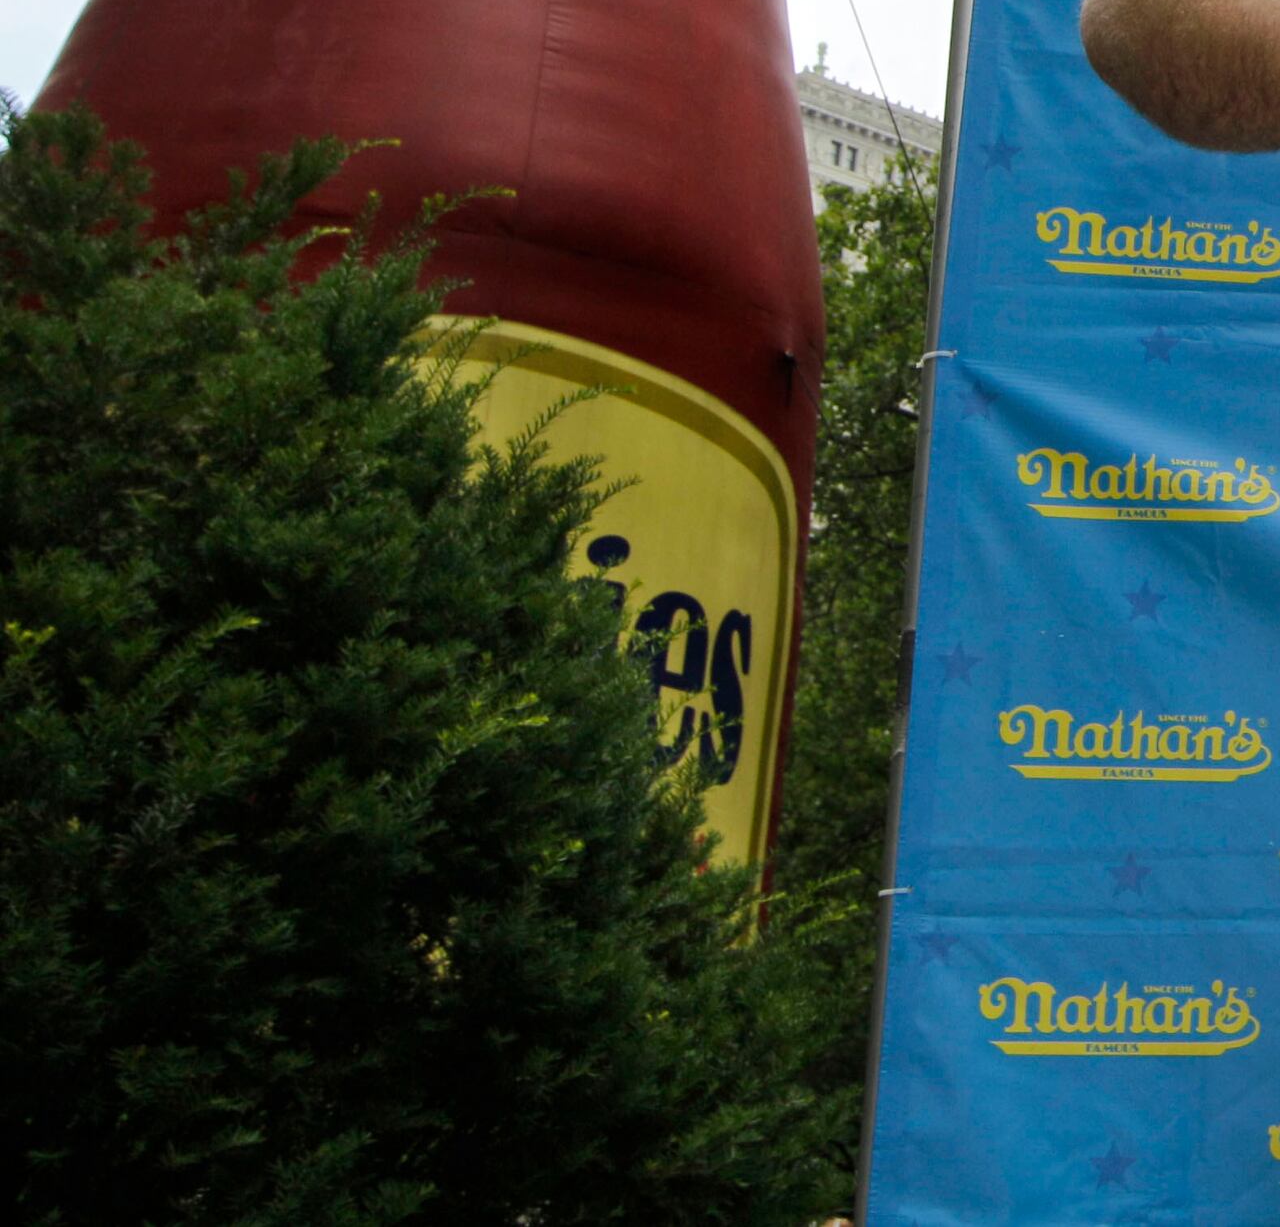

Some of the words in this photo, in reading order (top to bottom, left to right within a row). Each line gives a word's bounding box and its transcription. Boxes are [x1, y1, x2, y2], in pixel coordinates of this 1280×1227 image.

[1132, 266, 1182, 276] FAMOUS
[1016, 448, 1272, 504] Nathan's
[1117, 509, 1168, 518] FAMOUS
[998, 704, 1263, 761] Nathan's
[1102, 768, 1154, 778] FAMOUS
[979, 977, 1250, 1033] Nathan's
[1085, 1043, 1139, 1053] FAMOUS
